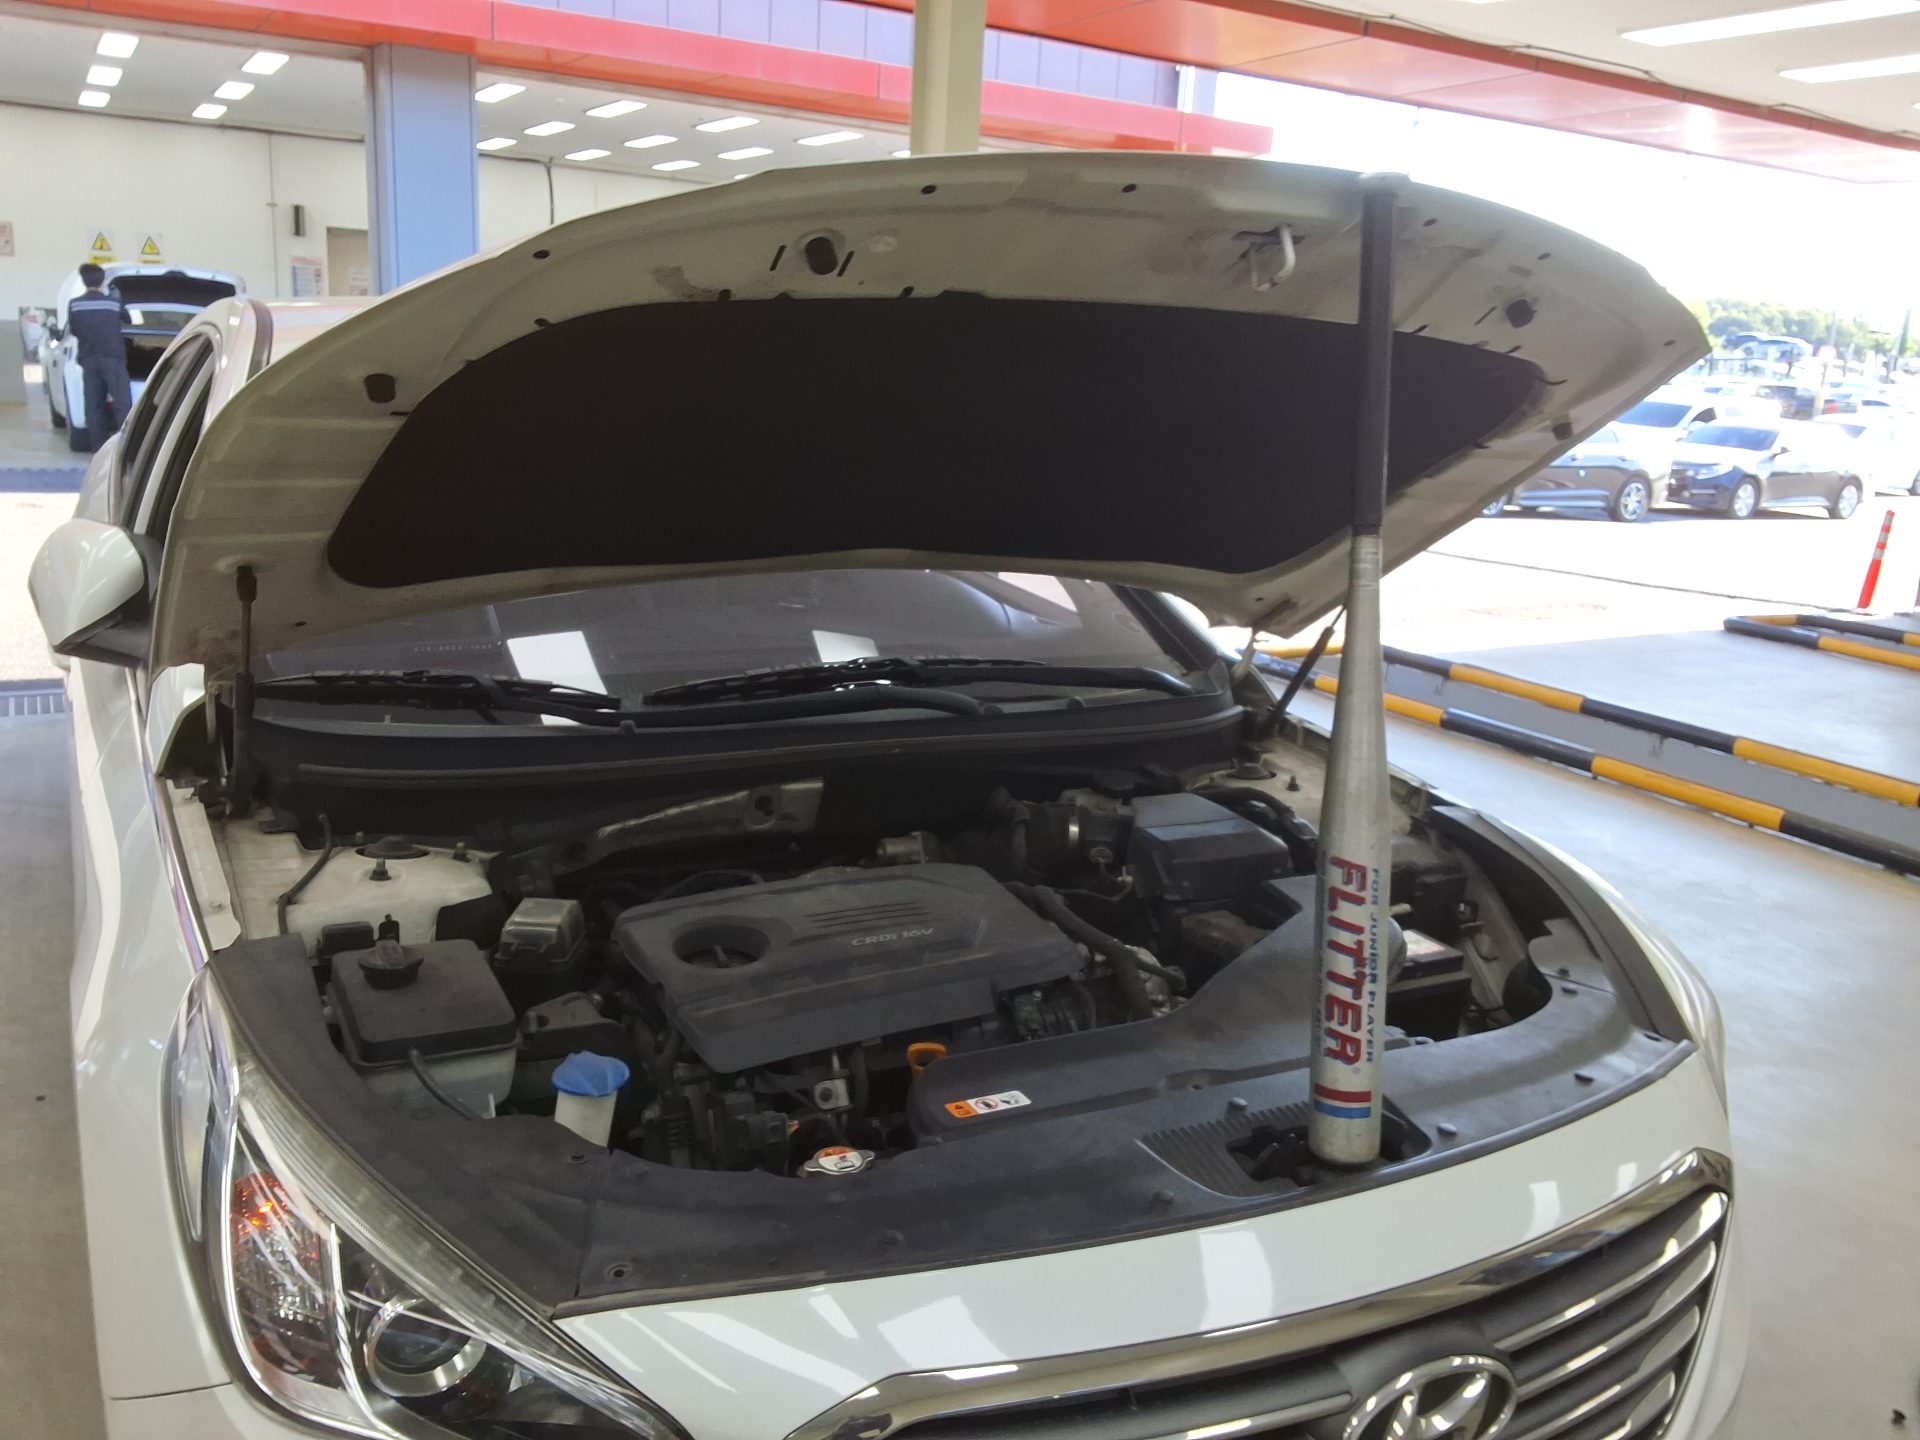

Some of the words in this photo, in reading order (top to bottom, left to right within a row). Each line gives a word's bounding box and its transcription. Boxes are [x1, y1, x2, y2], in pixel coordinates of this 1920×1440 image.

[1370, 868, 1380, 905] FOR
[1325, 856, 1367, 1065] FLITTER
[1368, 912, 1379, 984] JUNIOR
[1366, 991, 1377, 1062] PLAYER
